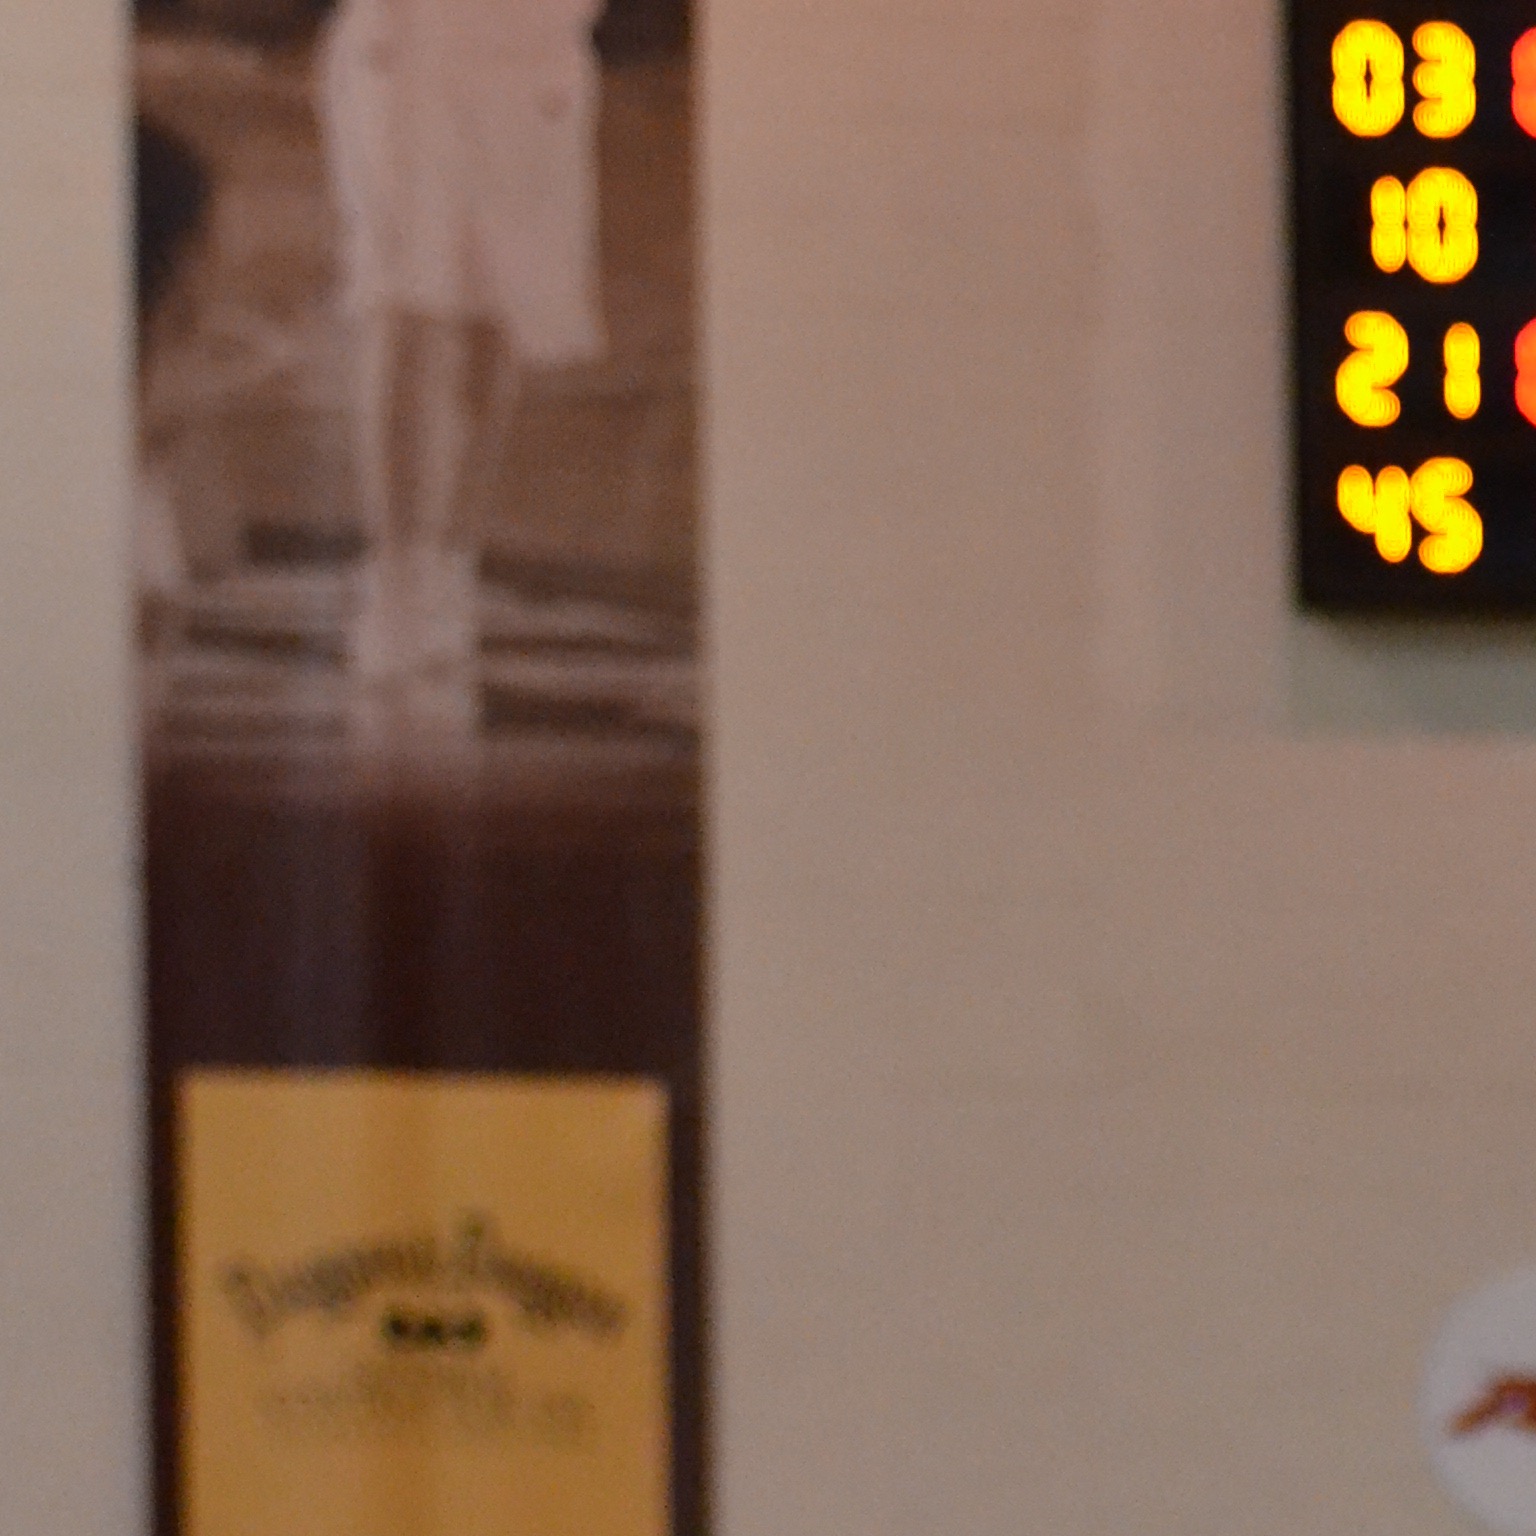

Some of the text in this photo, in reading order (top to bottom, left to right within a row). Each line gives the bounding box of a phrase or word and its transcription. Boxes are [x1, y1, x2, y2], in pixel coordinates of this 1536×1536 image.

[1331, 20, 1476, 138] 03
[1370, 167, 1478, 284] 10
[1335, 311, 1480, 427] 21
[1337, 457, 1483, 574] 45
